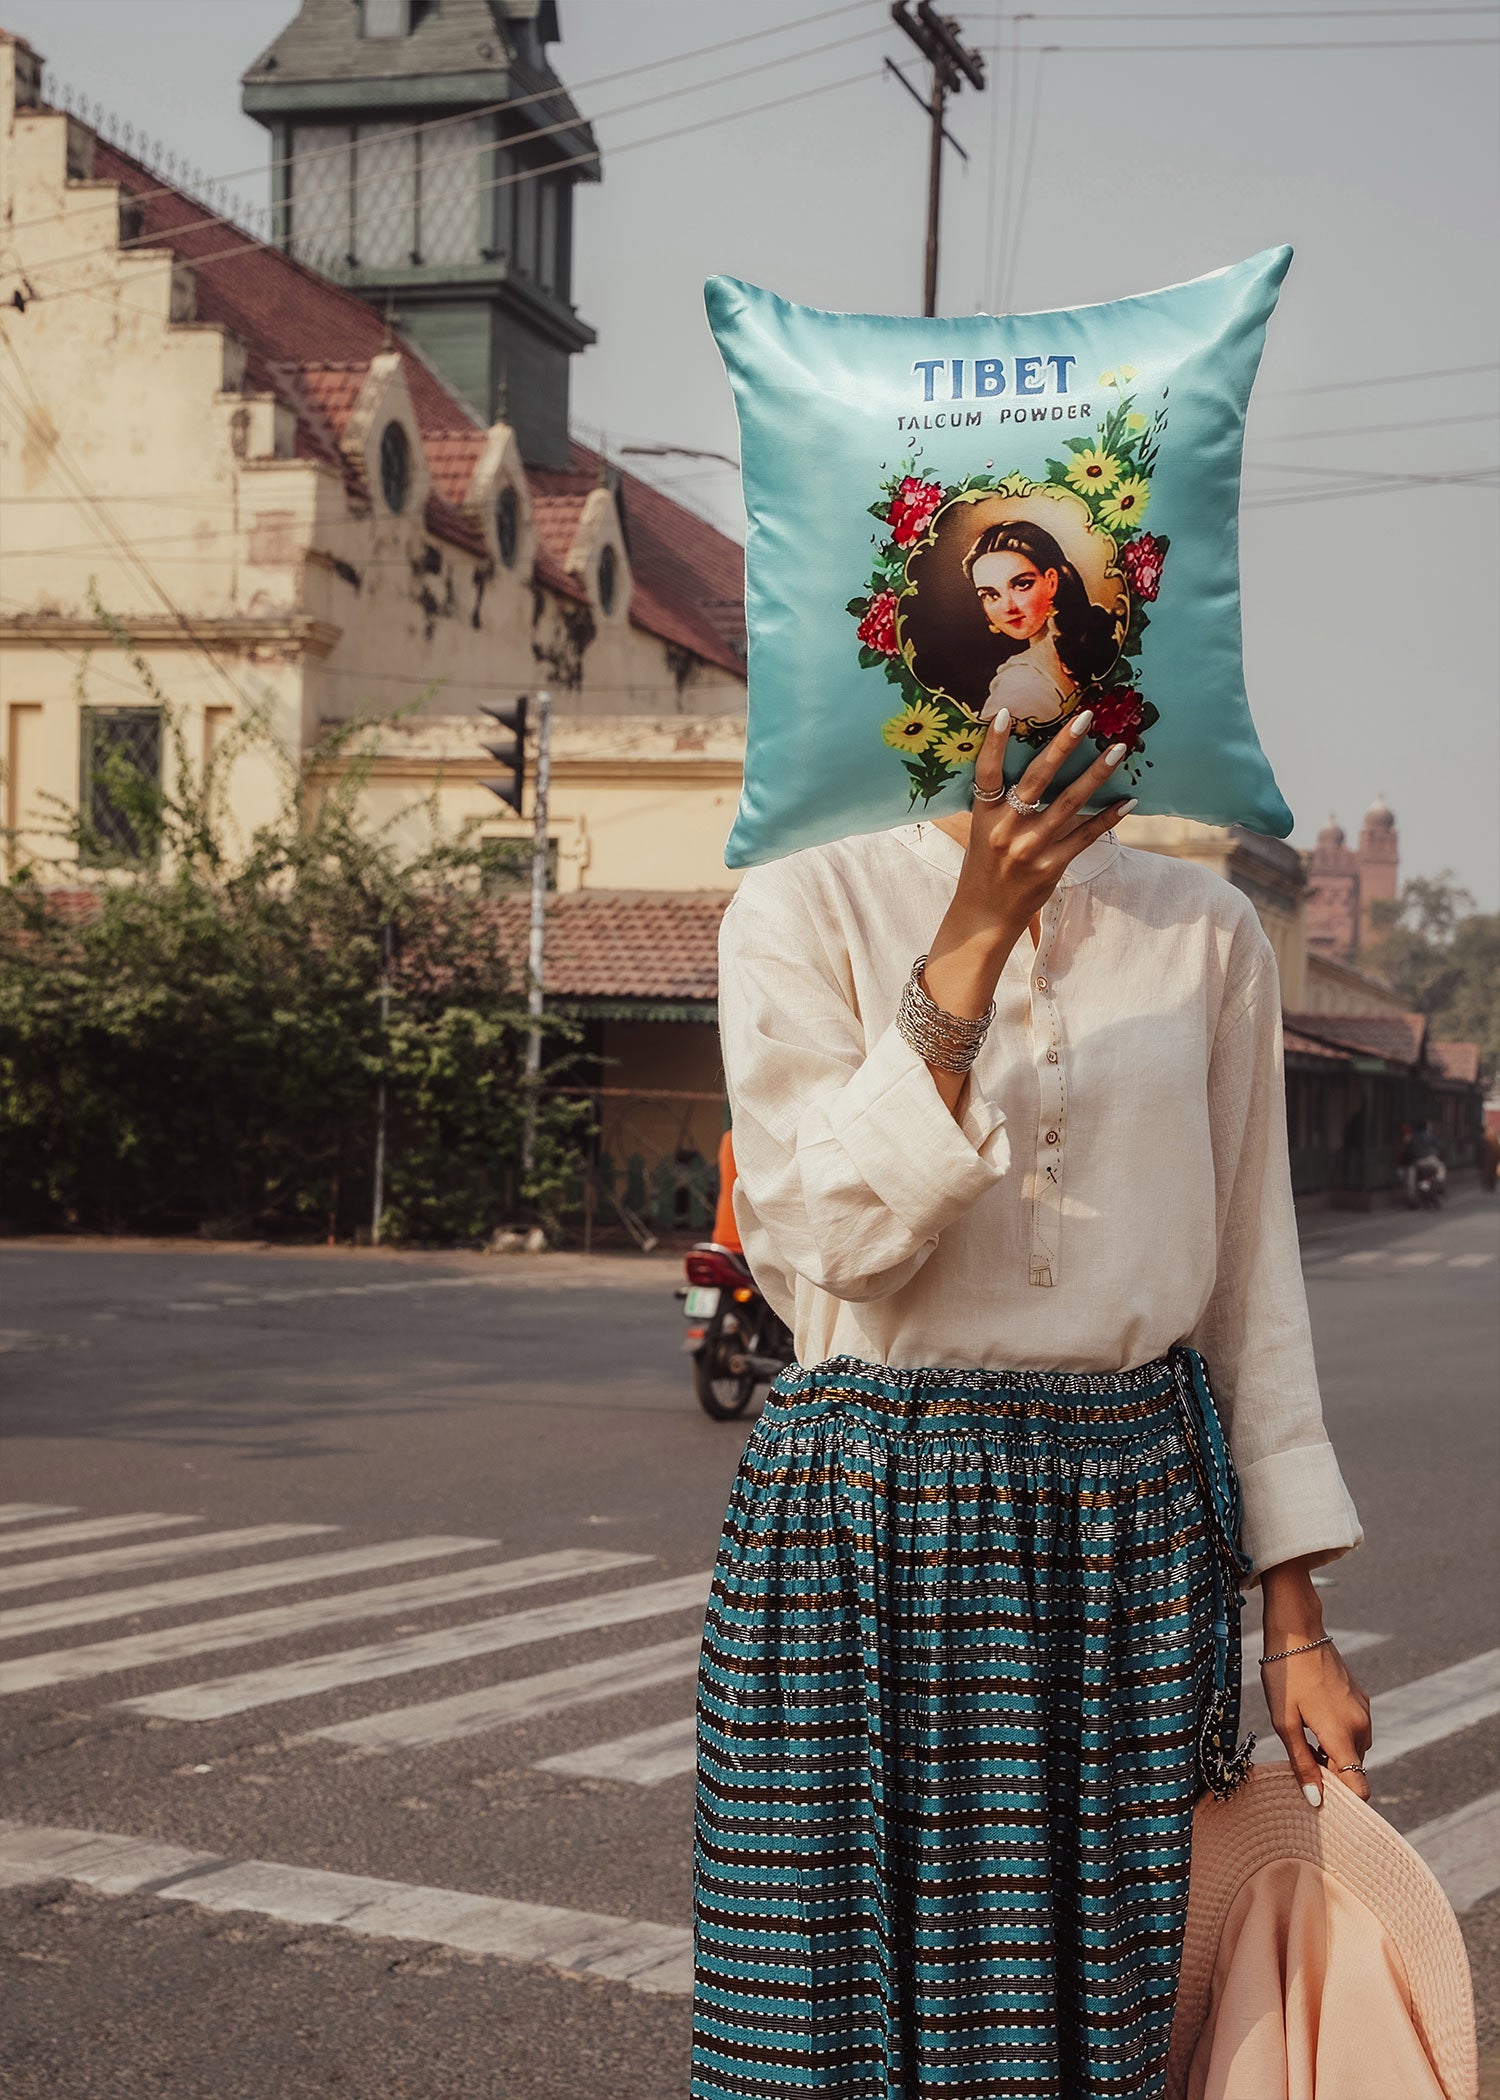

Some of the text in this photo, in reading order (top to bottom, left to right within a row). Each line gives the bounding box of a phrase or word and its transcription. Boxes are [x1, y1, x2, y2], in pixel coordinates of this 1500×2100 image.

[913, 355, 1077, 402] TIBET
[897, 403, 1091, 431] TALCUM POWDER
